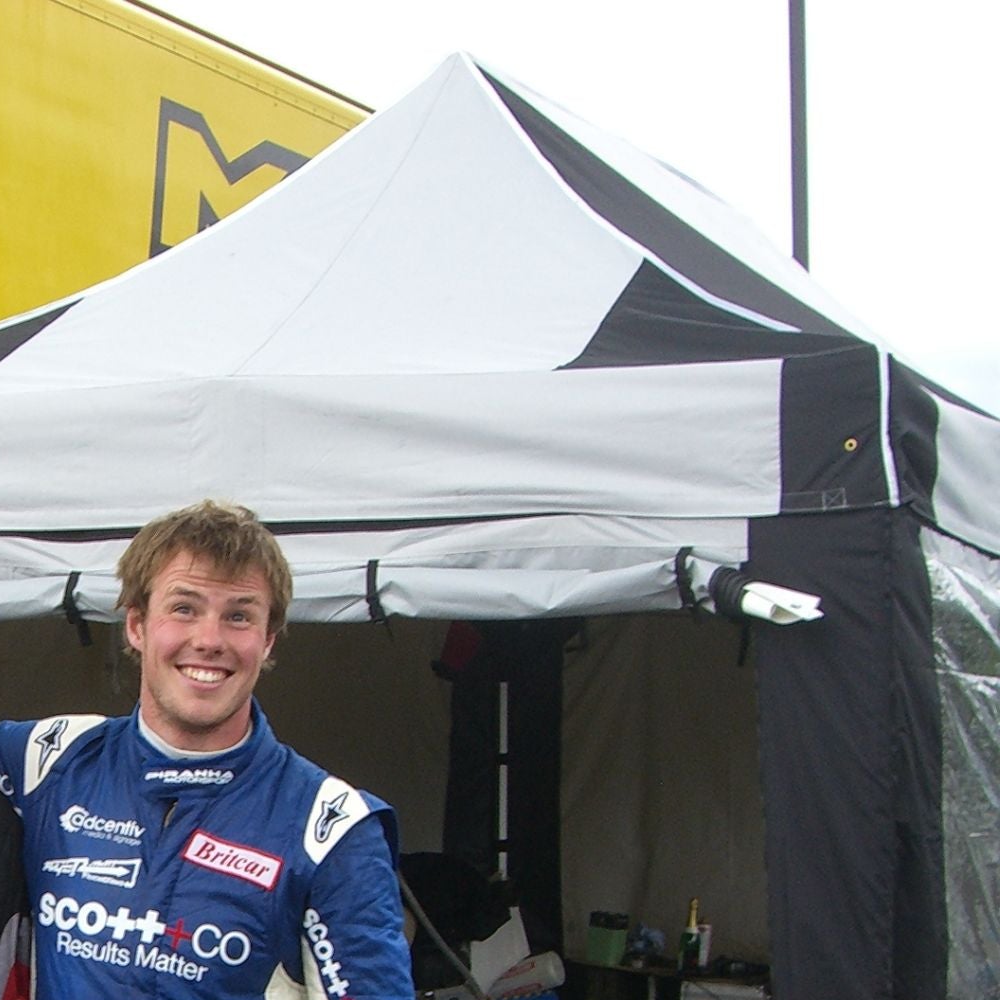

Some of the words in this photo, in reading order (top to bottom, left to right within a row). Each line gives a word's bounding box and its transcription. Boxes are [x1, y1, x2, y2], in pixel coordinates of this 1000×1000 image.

[193, 838, 272, 878] Britcar
[56, 930, 130, 967] Results
[135, 946, 208, 981] Matter
